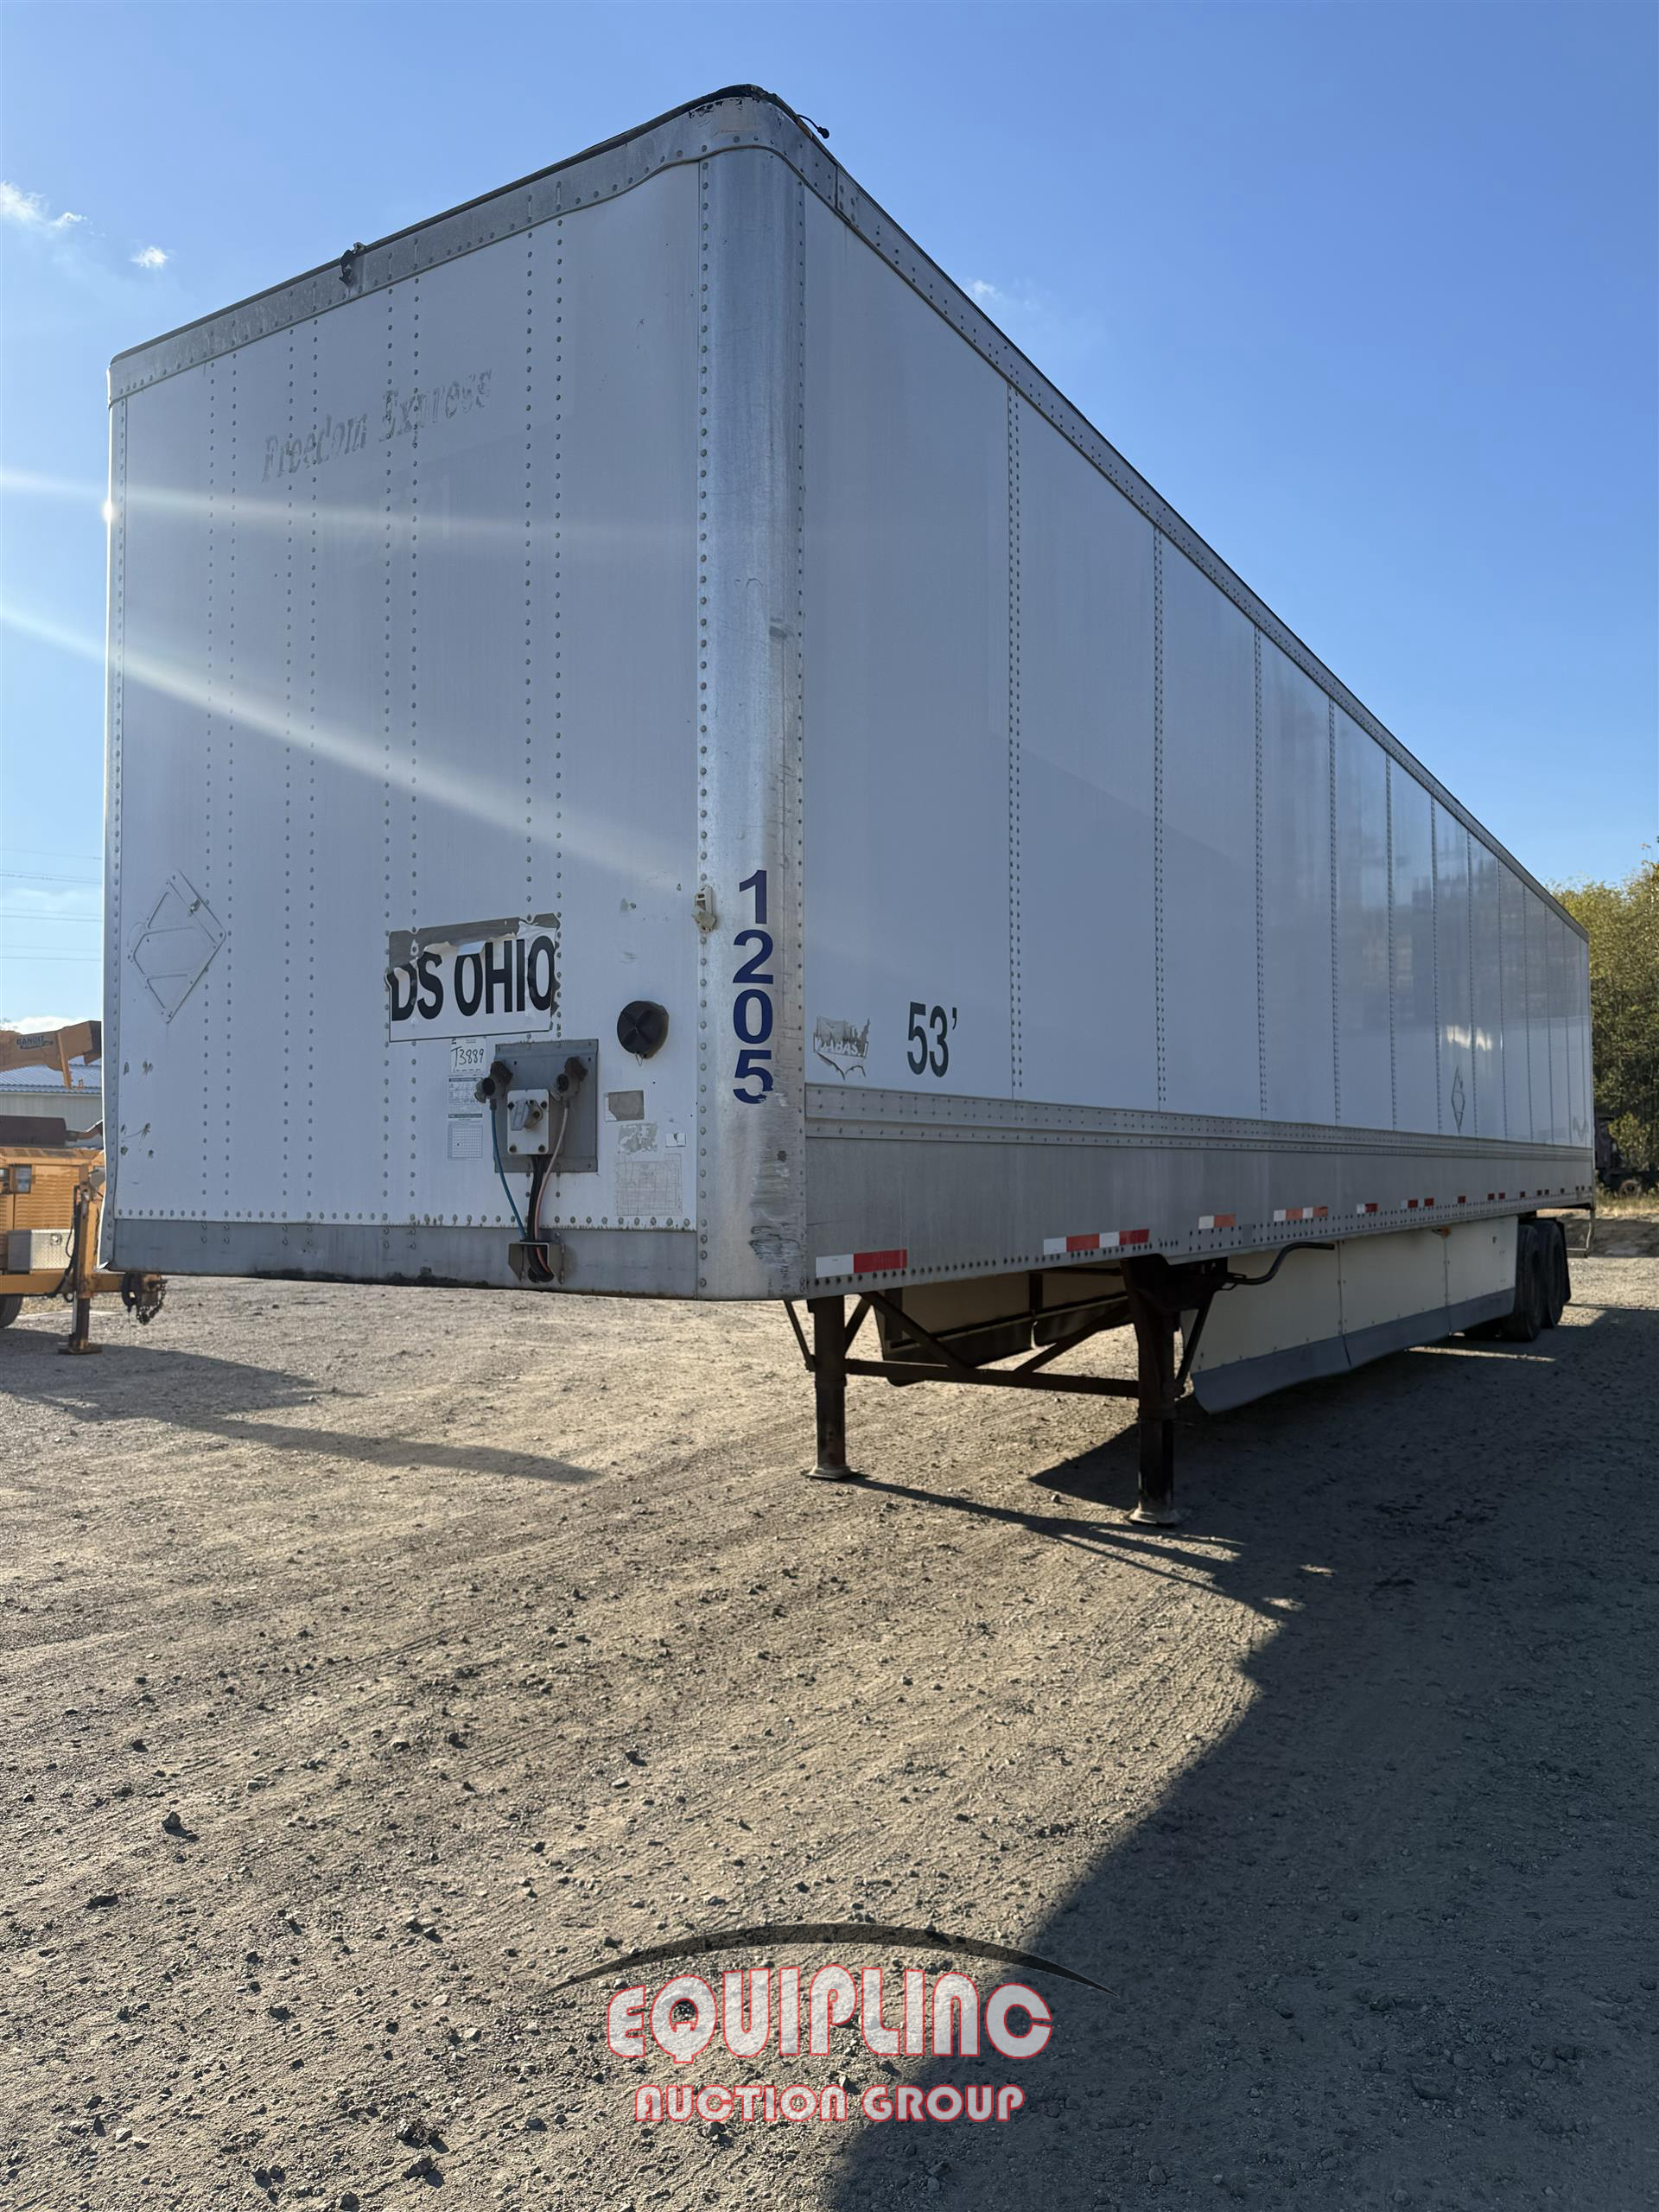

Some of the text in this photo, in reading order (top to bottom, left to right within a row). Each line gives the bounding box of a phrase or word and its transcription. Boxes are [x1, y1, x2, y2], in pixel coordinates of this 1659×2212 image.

[454, 936, 555, 1017] OHIO
[733, 869, 774, 1105] 1205
[907, 1001, 957, 1078] 53'
